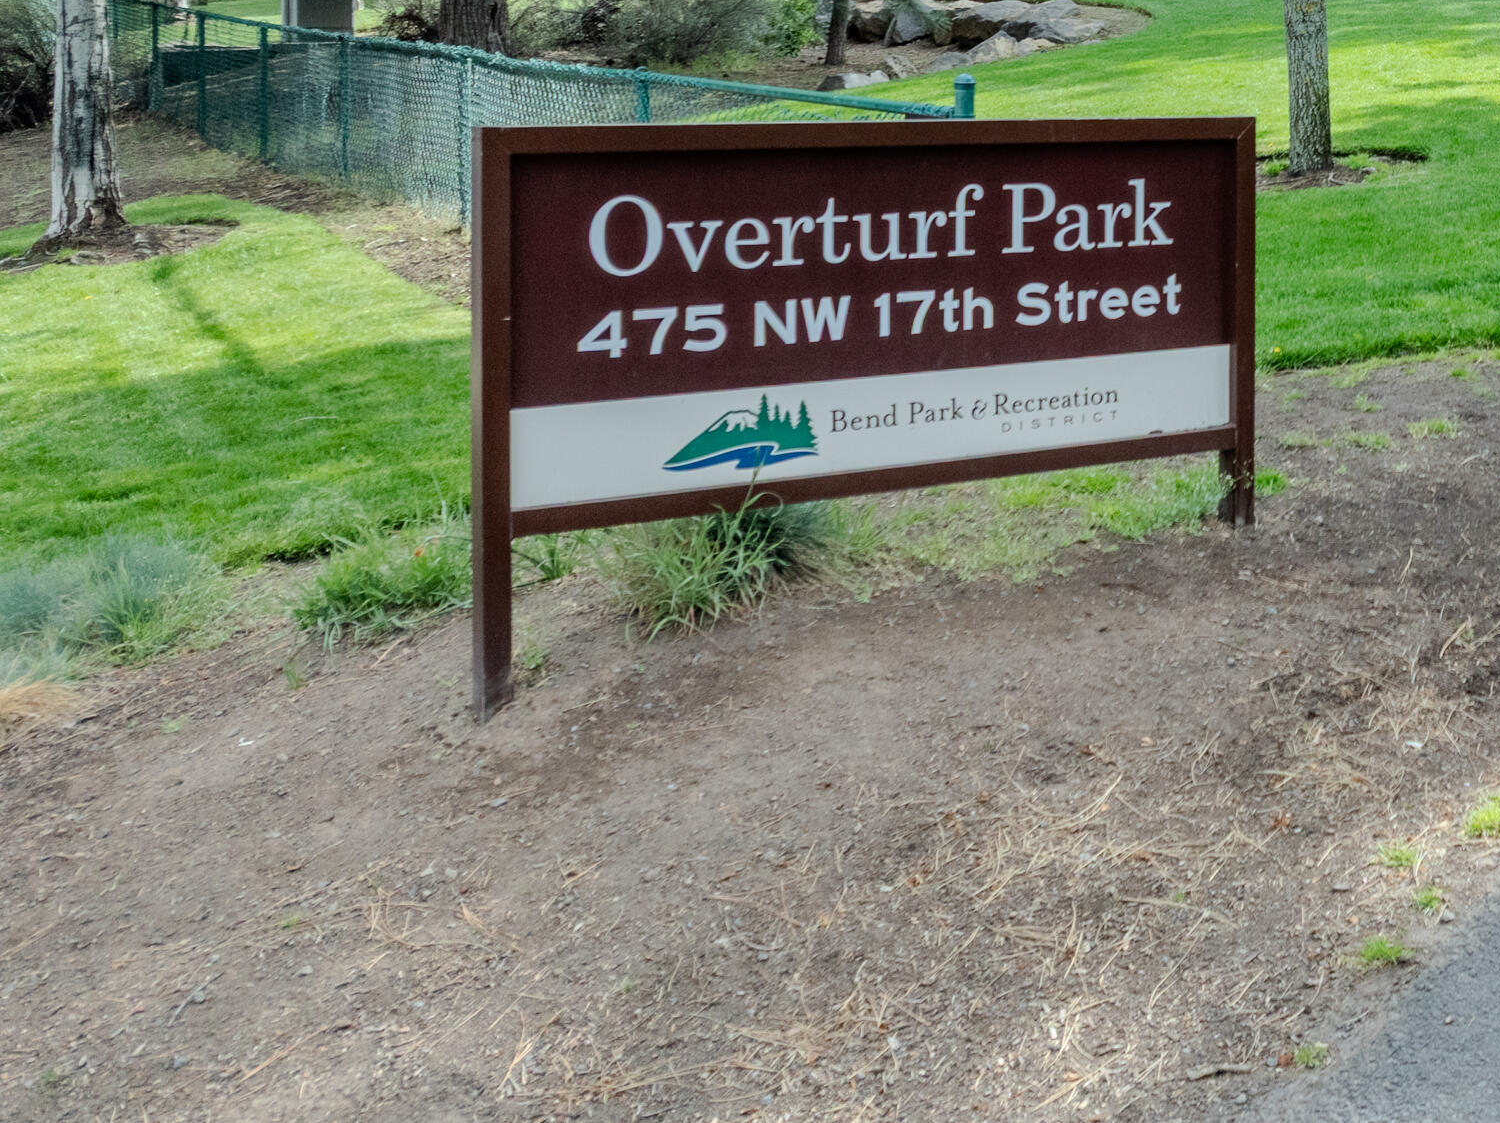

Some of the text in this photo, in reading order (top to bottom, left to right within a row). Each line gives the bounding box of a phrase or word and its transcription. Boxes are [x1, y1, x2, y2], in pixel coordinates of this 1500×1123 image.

[588, 178, 1174, 277] Overturf Park
[577, 273, 1182, 359] 475 NW 17th Street
[829, 387, 1119, 434] Bend Park & Recreation
[1000, 409, 1119, 433] DISTRICT
